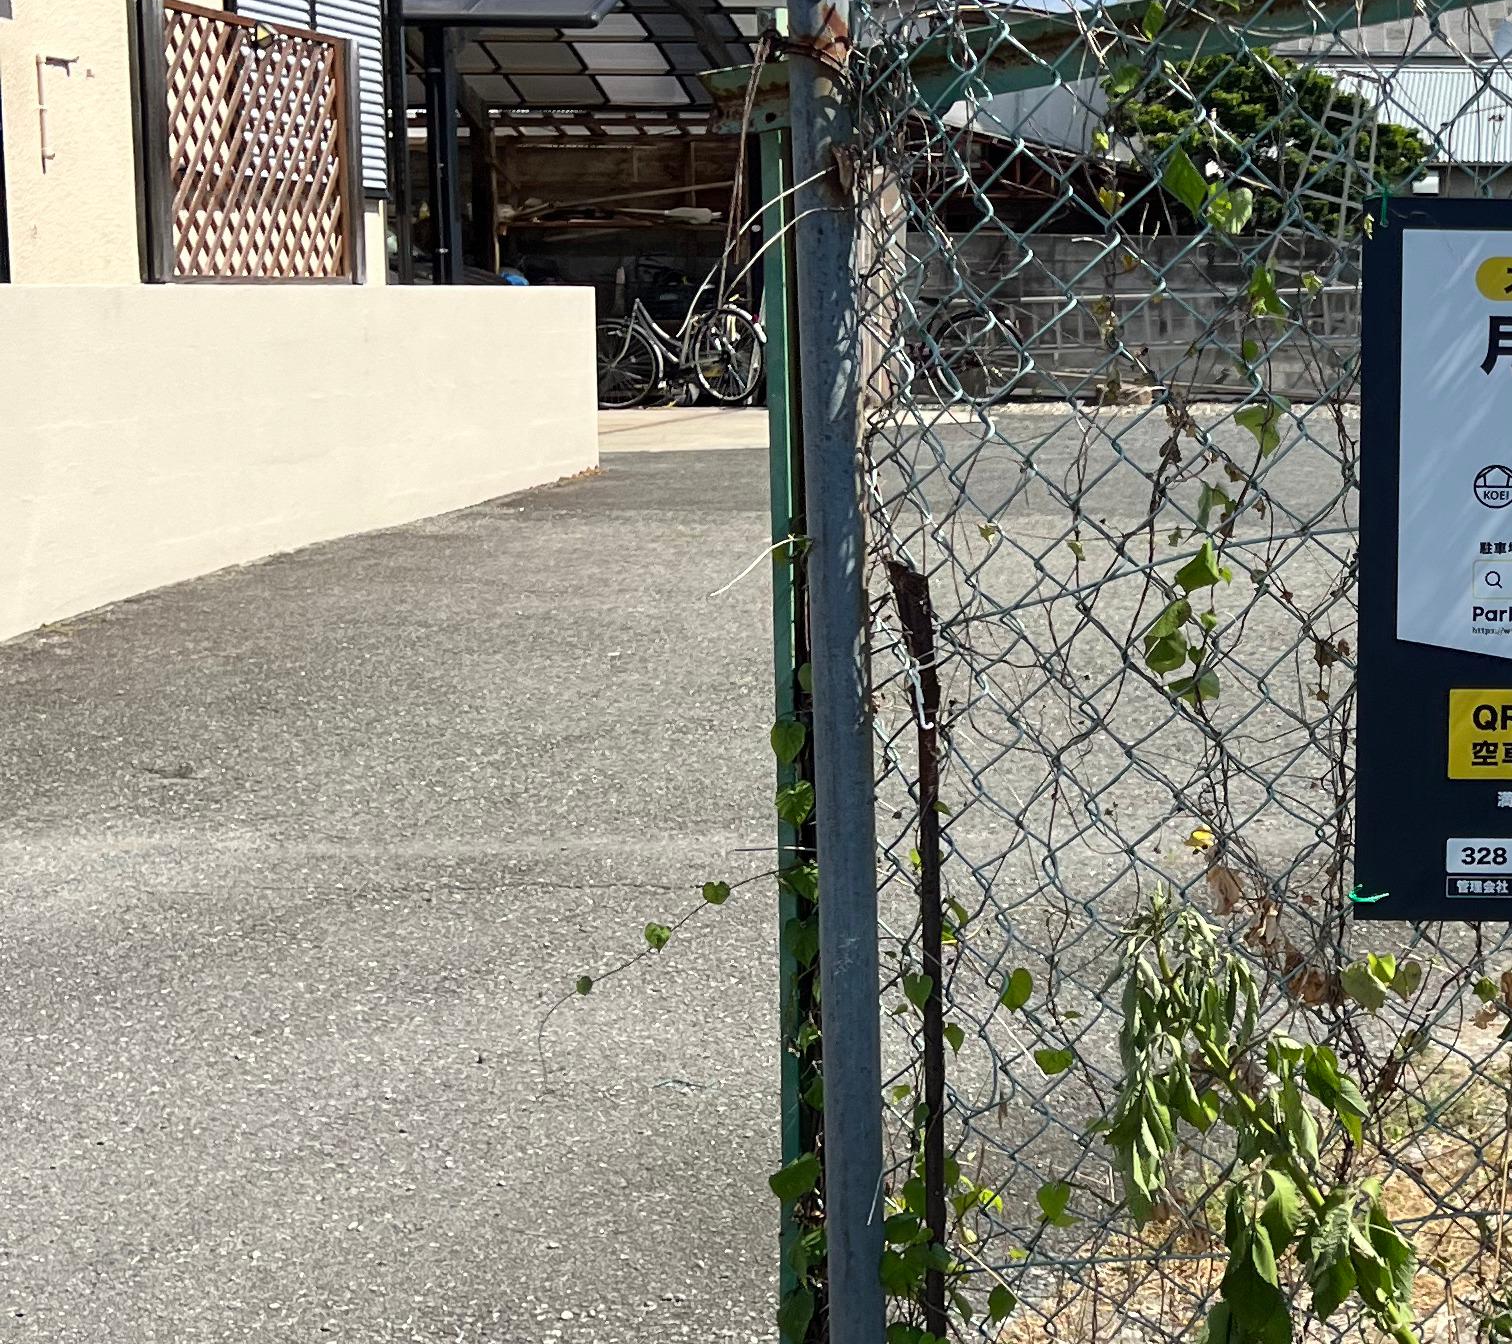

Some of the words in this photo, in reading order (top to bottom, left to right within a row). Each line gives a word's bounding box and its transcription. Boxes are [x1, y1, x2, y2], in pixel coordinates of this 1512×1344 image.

[1483, 490, 1510, 501] KOEI
[1461, 846, 1508, 866] 328
[1456, 879, 1509, 894] 管理会社
